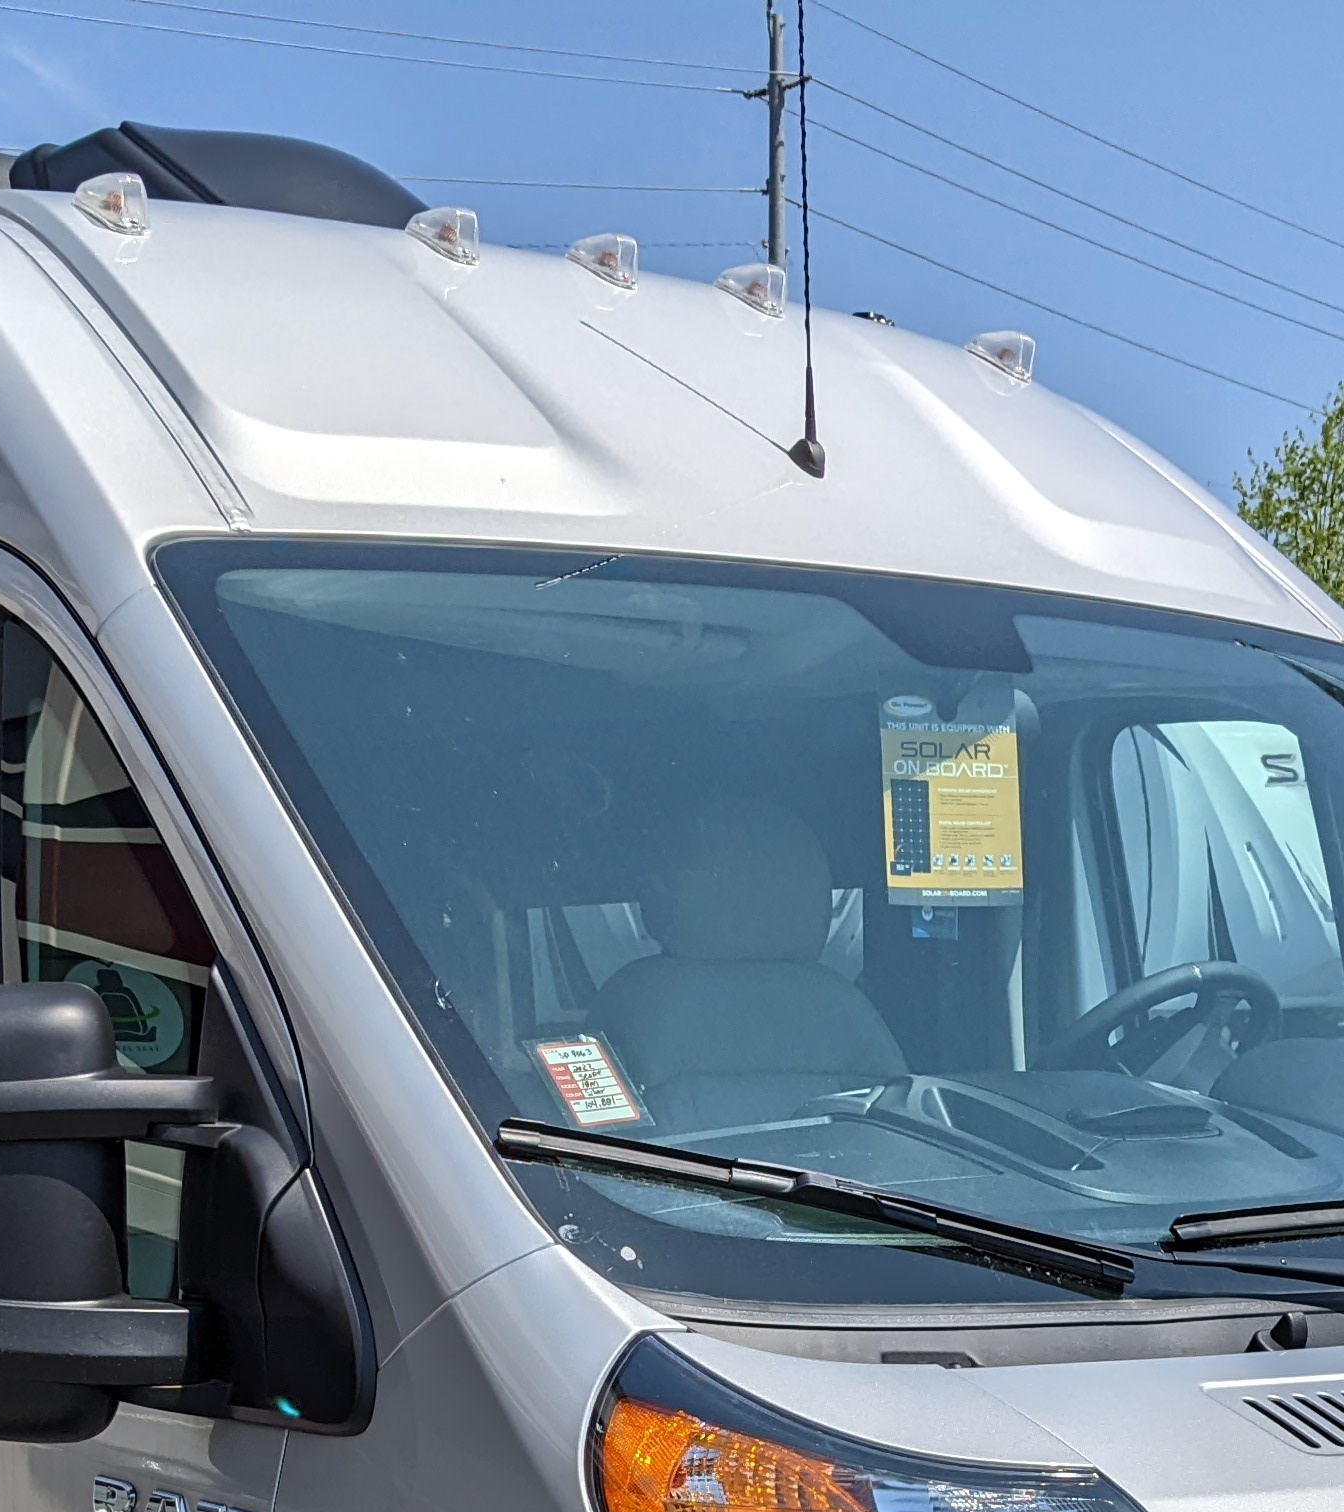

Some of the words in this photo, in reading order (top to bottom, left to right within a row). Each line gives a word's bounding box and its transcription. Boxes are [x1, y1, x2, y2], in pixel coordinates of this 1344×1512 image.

[886, 721, 907, 731] THIS
[908, 722, 929, 731] UNIT
[931, 723, 939, 732] IS
[941, 723, 985, 733] EQUIPPED
[986, 724, 1011, 734] WITH
[900, 741, 991, 760] SOLAR
[893, 759, 920, 775] ON
[925, 761, 1004, 778] BOARD
